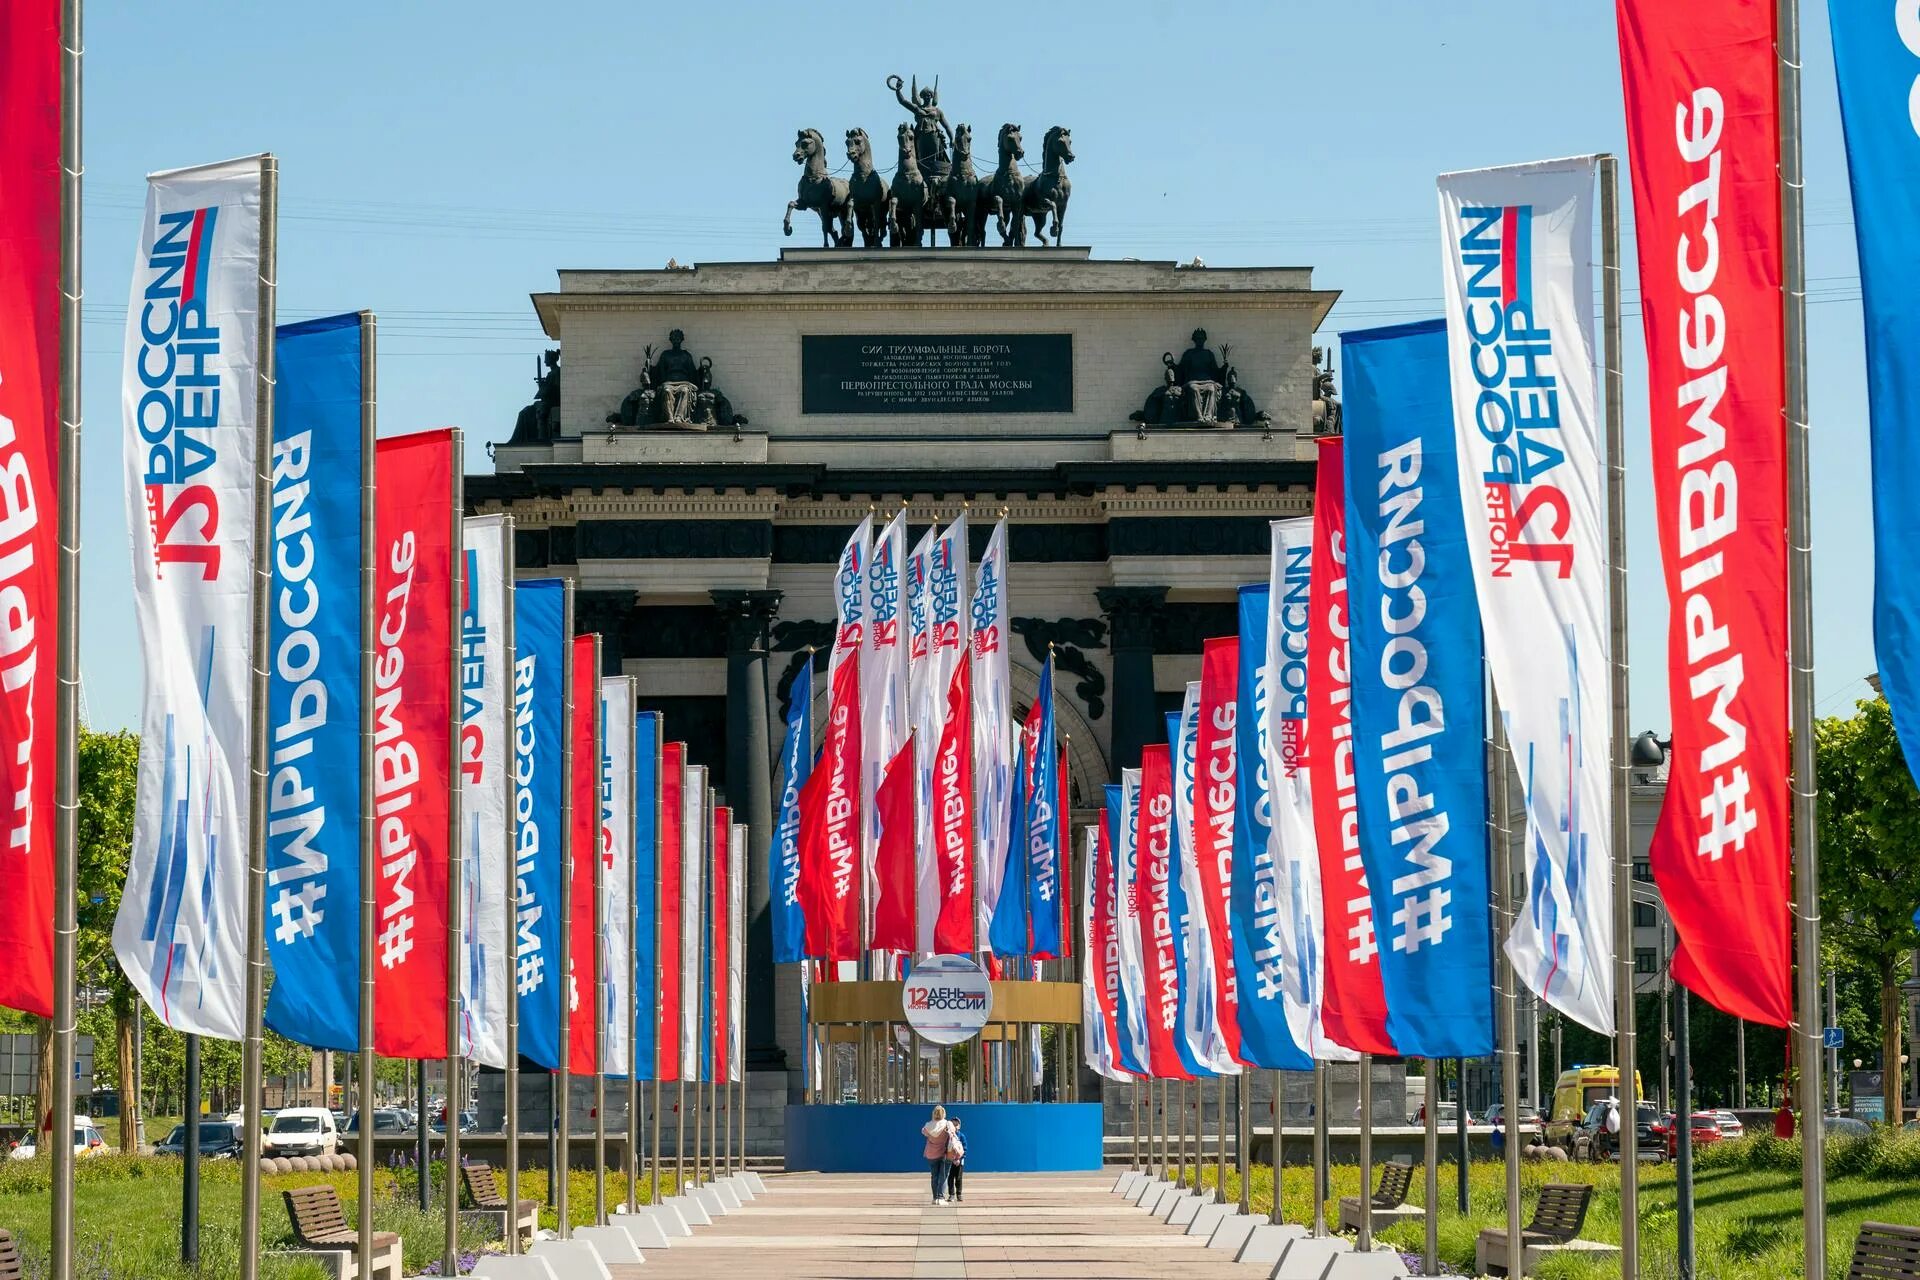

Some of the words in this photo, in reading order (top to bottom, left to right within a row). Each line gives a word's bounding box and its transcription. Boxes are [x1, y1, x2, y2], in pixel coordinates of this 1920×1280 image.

[861, 345, 882, 354] СИИ
[889, 345, 967, 354] ТРИУМФАЛЬНЫЕ
[973, 344, 1011, 354] ВОРОТА
[841, 381, 950, 390] ПЕРВОПРЕСТОЛЬНОГО
[955, 381, 984, 389] ГРАДА
[989, 380, 1033, 389] МОСКВЫ
[907, 987, 928, 1005] 12
[928, 987, 966, 999] ДЕНЬ
[927, 998, 986, 1010] РОССИИ
